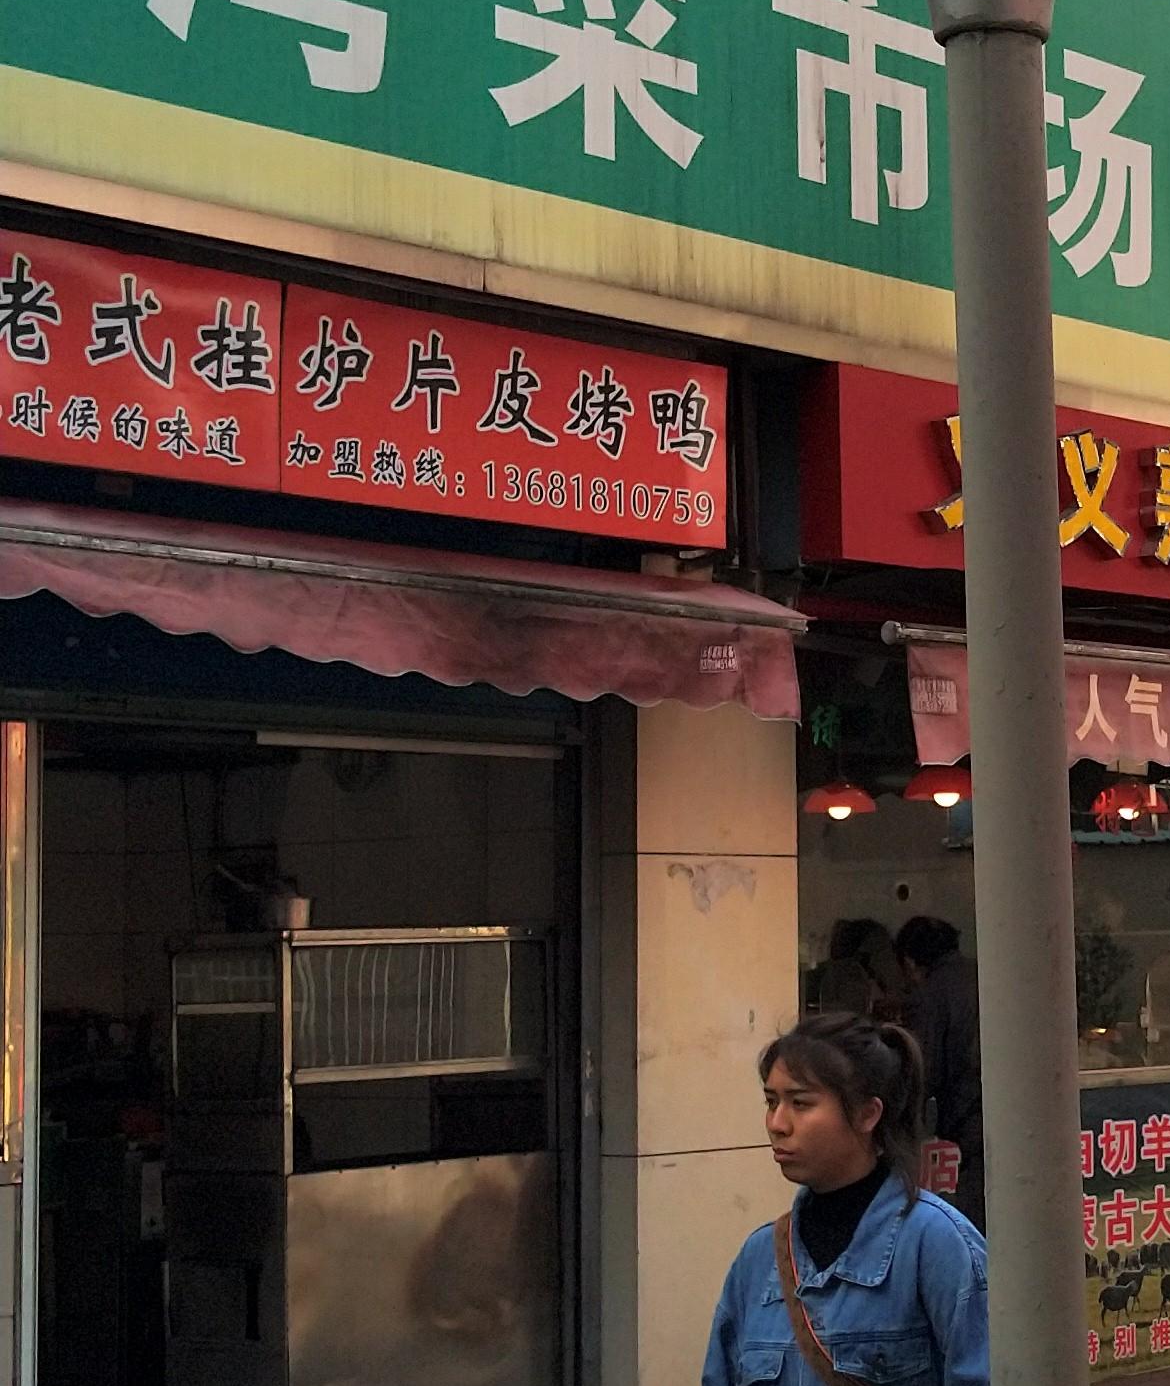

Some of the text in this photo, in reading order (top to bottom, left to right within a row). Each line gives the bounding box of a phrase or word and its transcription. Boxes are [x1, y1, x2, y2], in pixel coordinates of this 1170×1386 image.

[0, 253, 717, 471] 老式挂炉片皮烤鸭
[9, 386, 246, 466] 时候的味道
